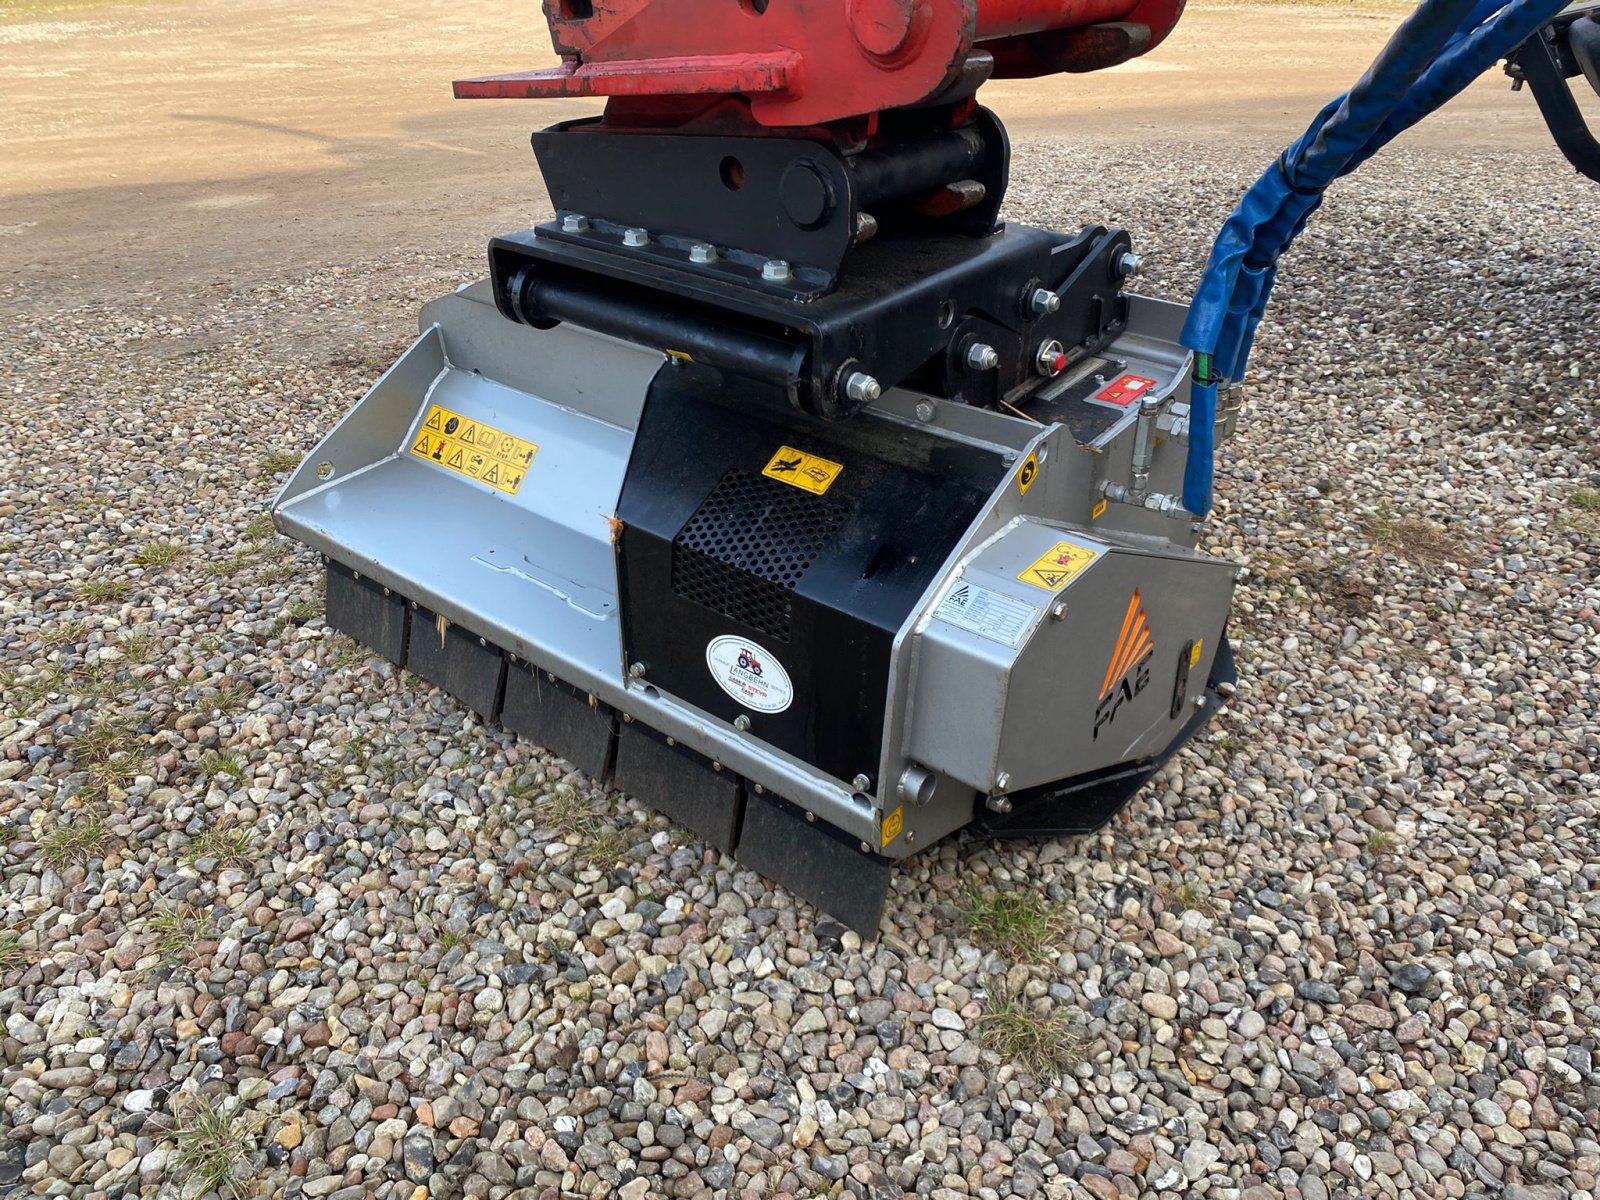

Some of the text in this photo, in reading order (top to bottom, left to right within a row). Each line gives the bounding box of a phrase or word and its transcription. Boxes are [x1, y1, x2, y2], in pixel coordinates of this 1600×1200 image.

[948, 595, 969, 606] FAE
[729, 665, 770, 689] LANGBEHN
[1092, 649, 1154, 742] FAE
